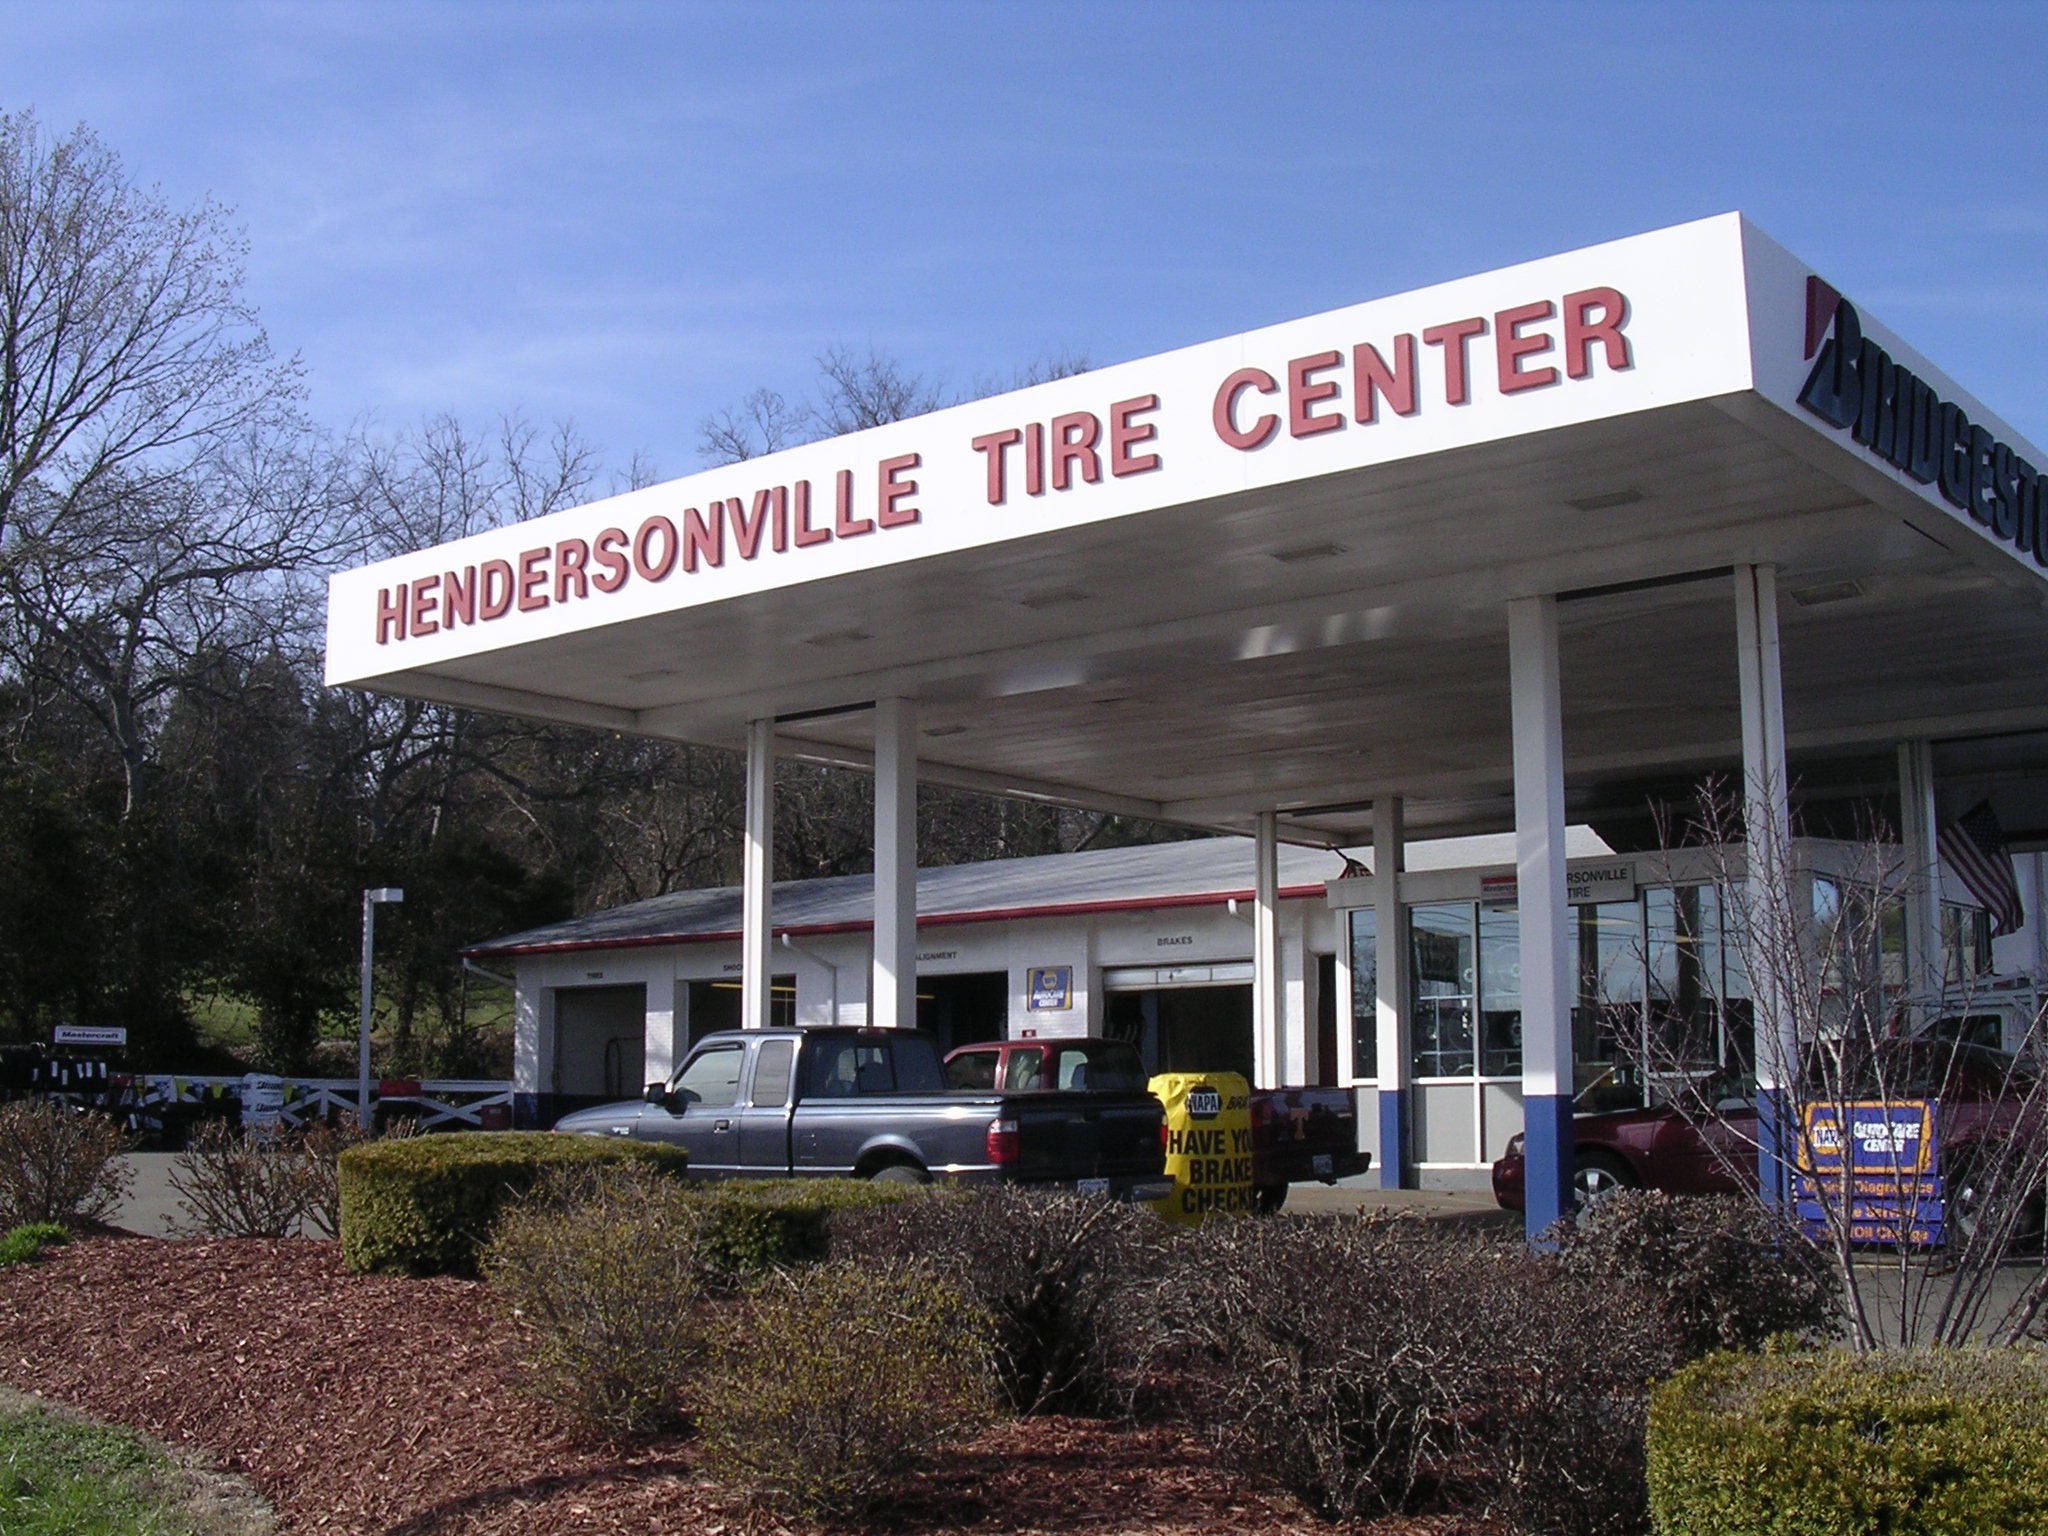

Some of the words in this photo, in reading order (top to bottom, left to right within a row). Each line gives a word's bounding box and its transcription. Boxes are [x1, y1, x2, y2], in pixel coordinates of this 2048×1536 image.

[375, 452, 923, 645] HENDERSONVILLE
[972, 393, 1161, 506] TIRE
[1212, 286, 1634, 452] CENTER
[1157, 936, 1193, 946] BRAKES
[1187, 1093, 1219, 1112] NAPA
[1169, 1129, 1225, 1154] HAVE
